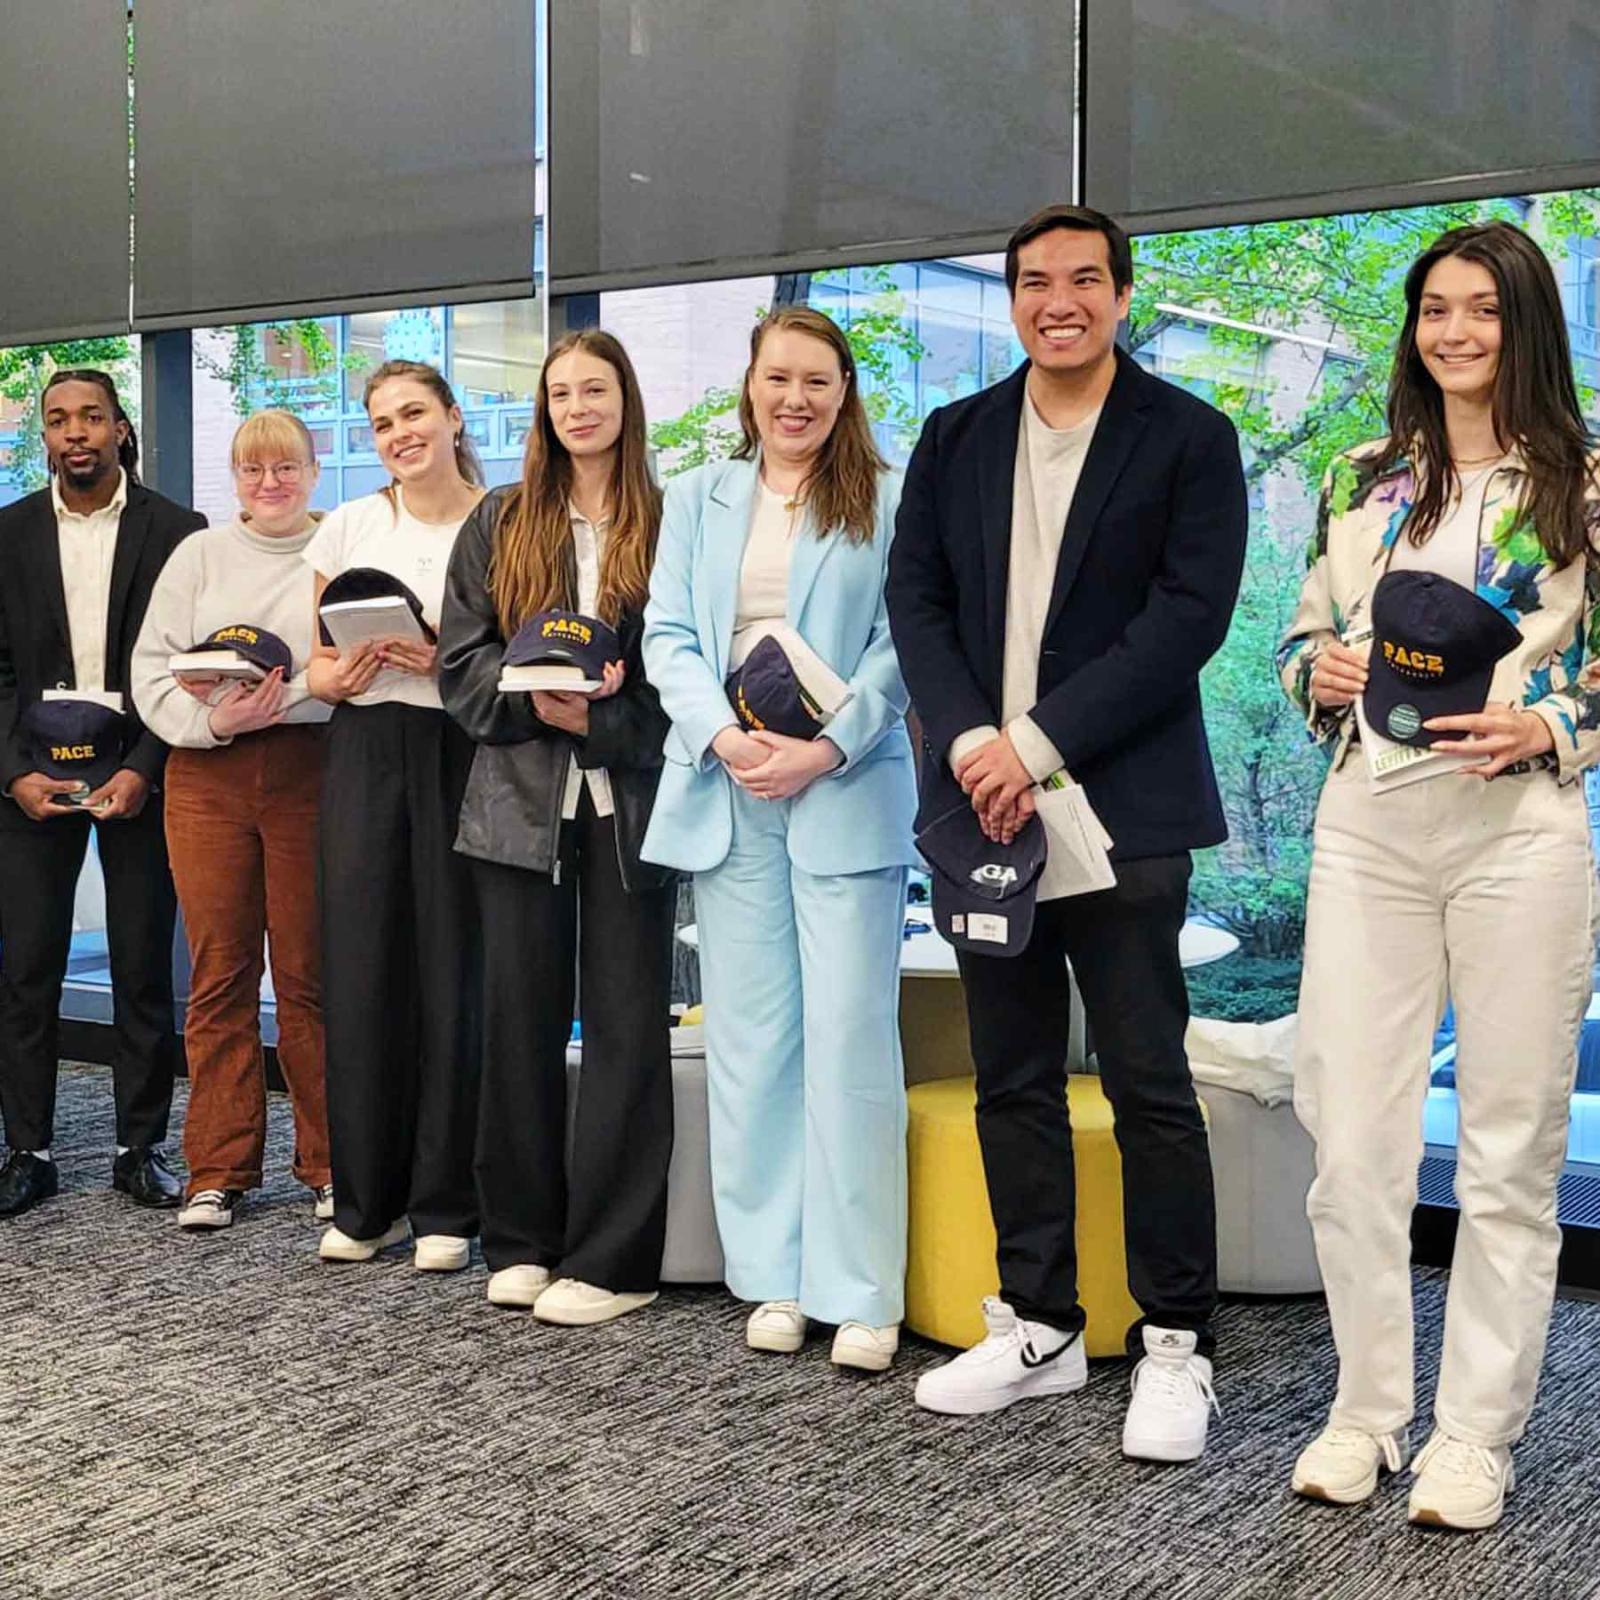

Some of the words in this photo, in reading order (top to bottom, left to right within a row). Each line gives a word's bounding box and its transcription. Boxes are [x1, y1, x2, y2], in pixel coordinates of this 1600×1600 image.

[542, 619, 591, 641] PACE
[1383, 641, 1444, 672] PACE
[51, 745, 96, 760] PACE
